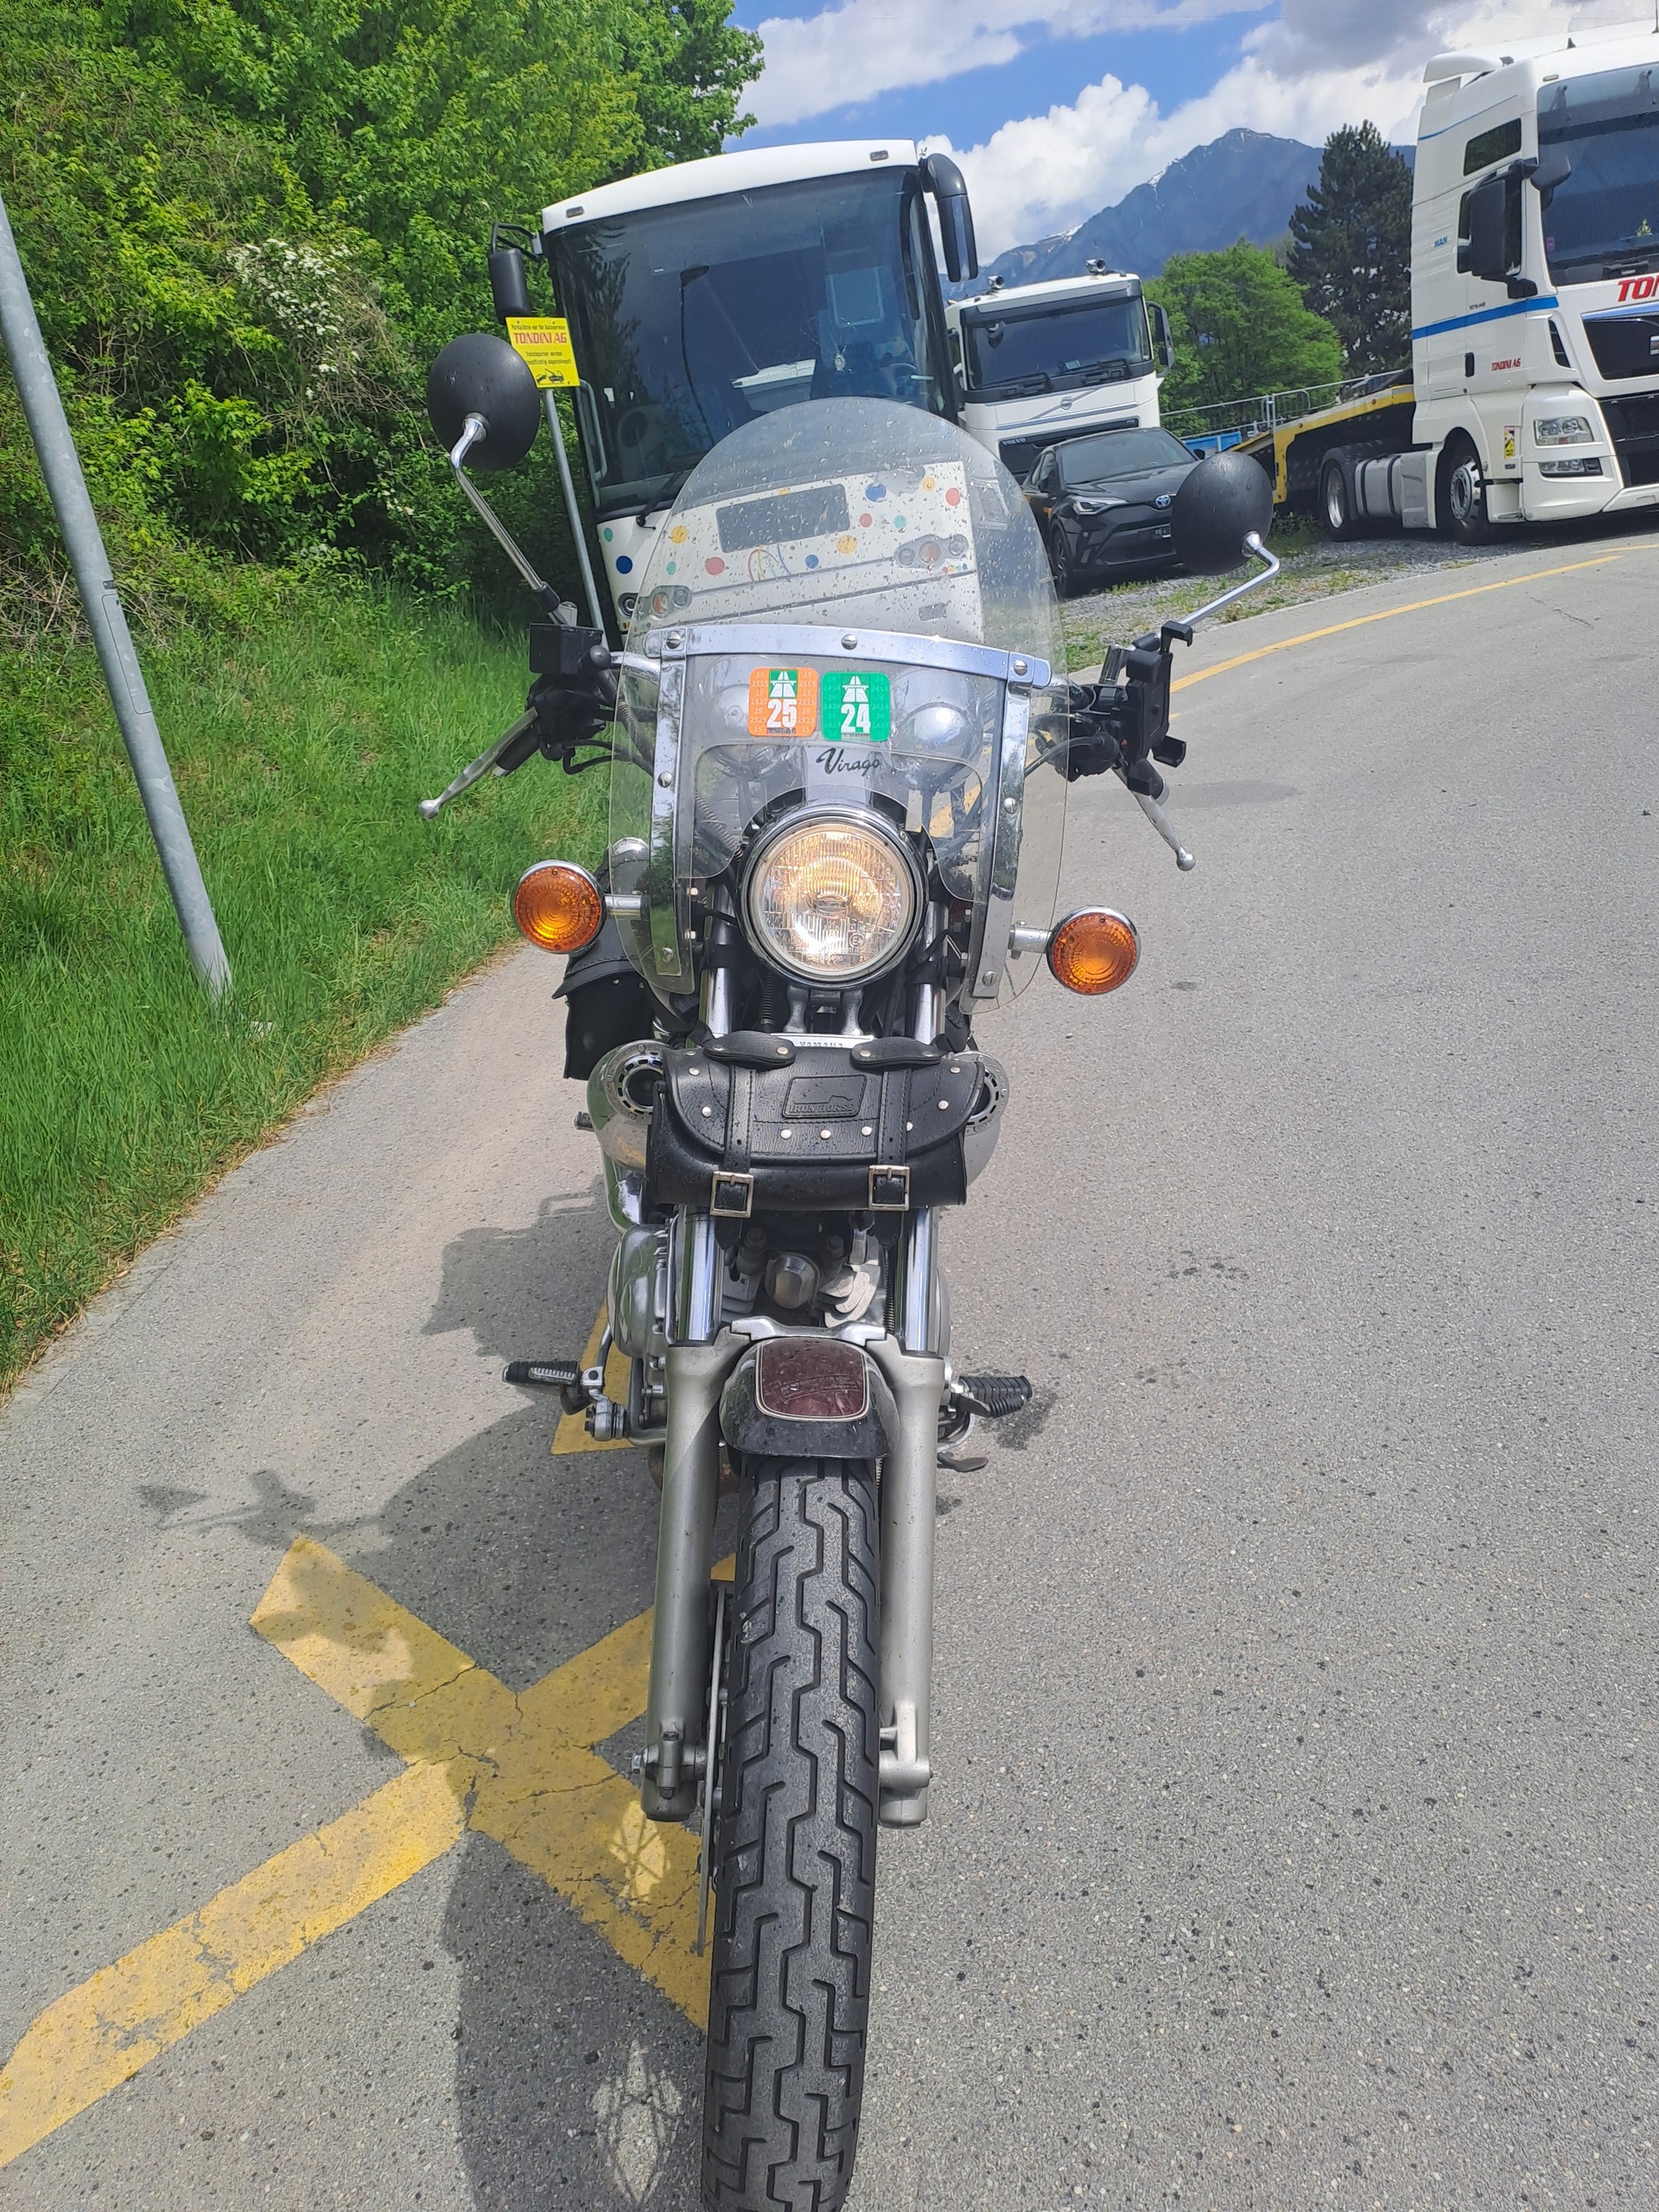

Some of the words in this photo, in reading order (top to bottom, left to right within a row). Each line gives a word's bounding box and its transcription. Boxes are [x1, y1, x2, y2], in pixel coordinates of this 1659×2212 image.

[513, 333, 552, 344] TONDINI
[553, 332, 568, 344] AG
[766, 699, 797, 728] 25
[841, 703, 871, 733] 24
[816, 747, 880, 777] Virago
[789, 1104, 817, 1113] IRON
[817, 1103, 854, 1113] HORSE
